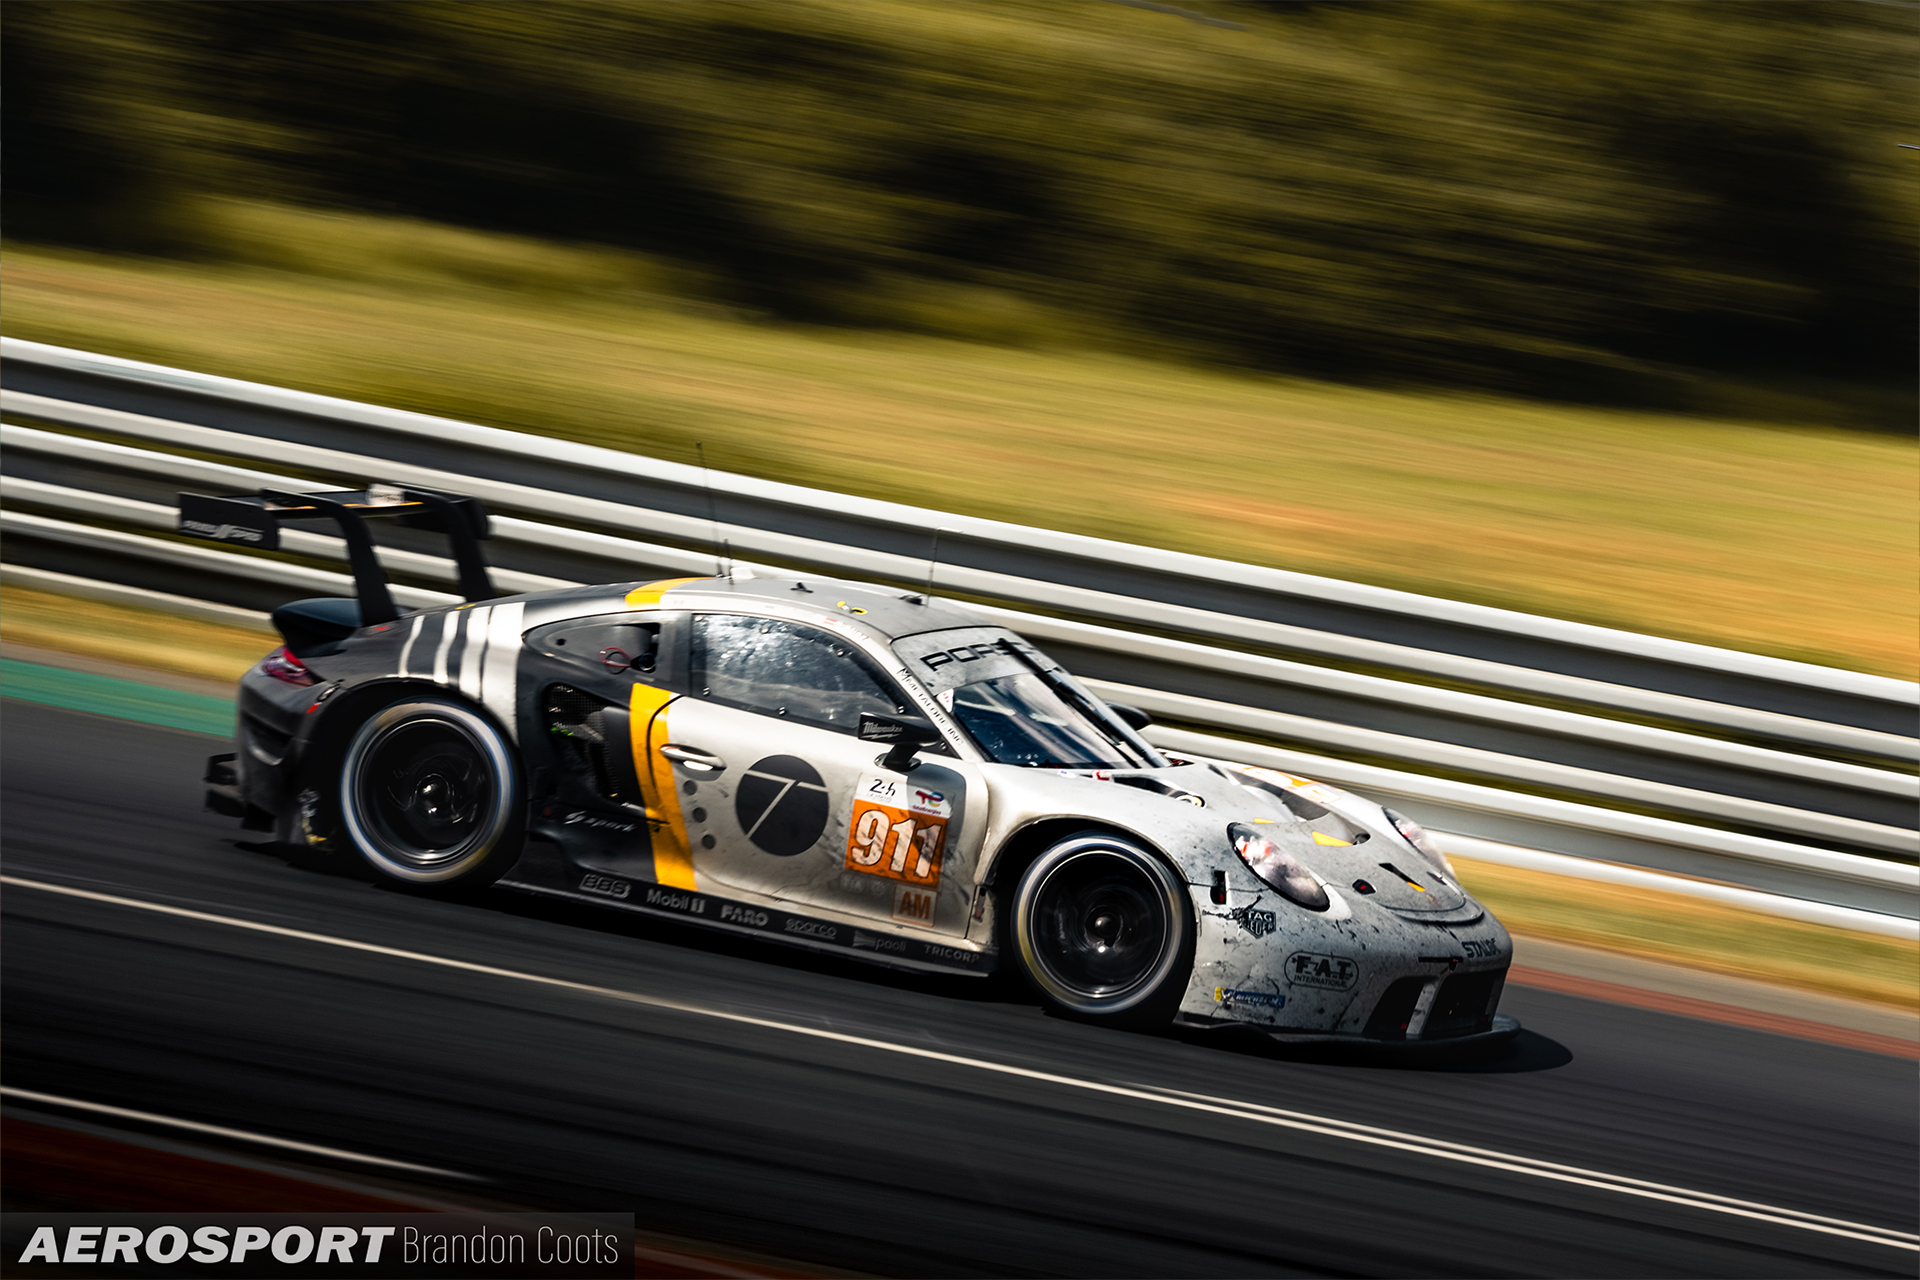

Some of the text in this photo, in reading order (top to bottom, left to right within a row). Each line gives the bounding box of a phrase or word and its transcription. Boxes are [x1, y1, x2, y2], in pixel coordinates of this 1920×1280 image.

[851, 808, 943, 879] 911
[646, 888, 690, 911] Mobil
[898, 890, 931, 920] AM
[721, 904, 769, 927] FARO
[1246, 911, 1273, 923] TAG
[924, 944, 981, 963] TRICORP
